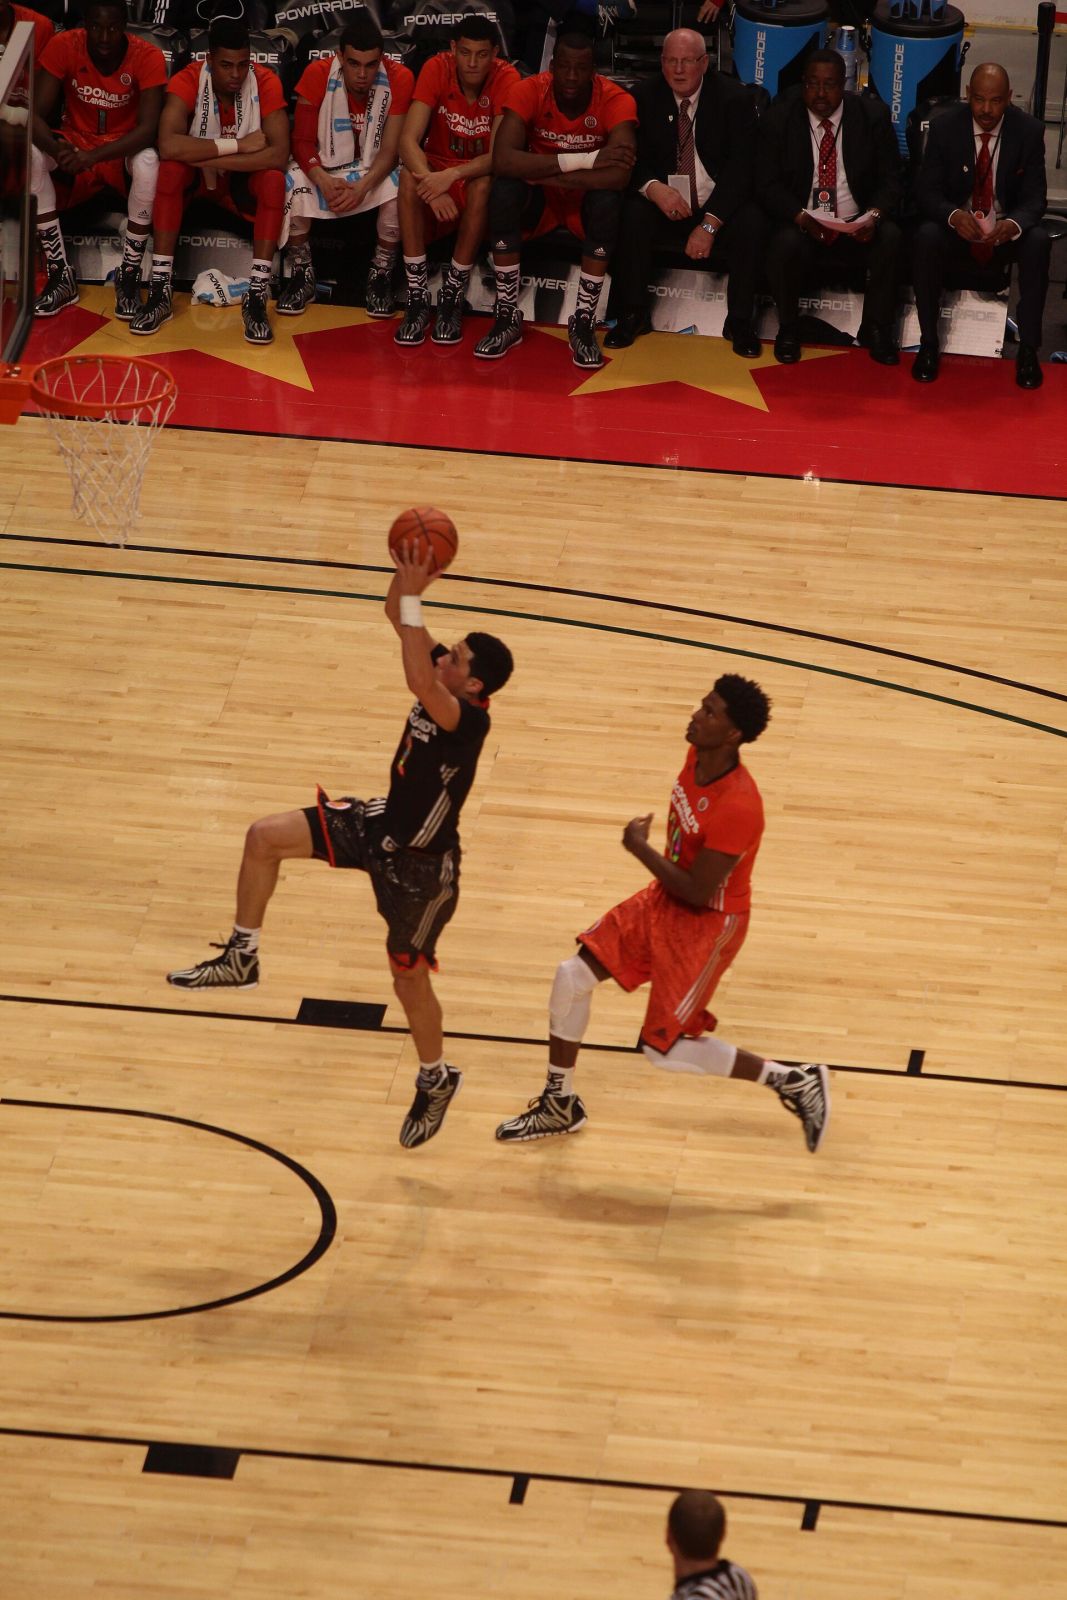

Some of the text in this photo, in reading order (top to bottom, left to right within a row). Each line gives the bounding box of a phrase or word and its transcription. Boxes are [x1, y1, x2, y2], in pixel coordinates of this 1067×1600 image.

[275, 0, 364, 24] POWERADE
[403, 12, 497, 27] POWERE
[891, 43, 905, 124] POWERADE
[207, 272, 228, 305] POWER
[647, 284, 726, 302] POWERAD
